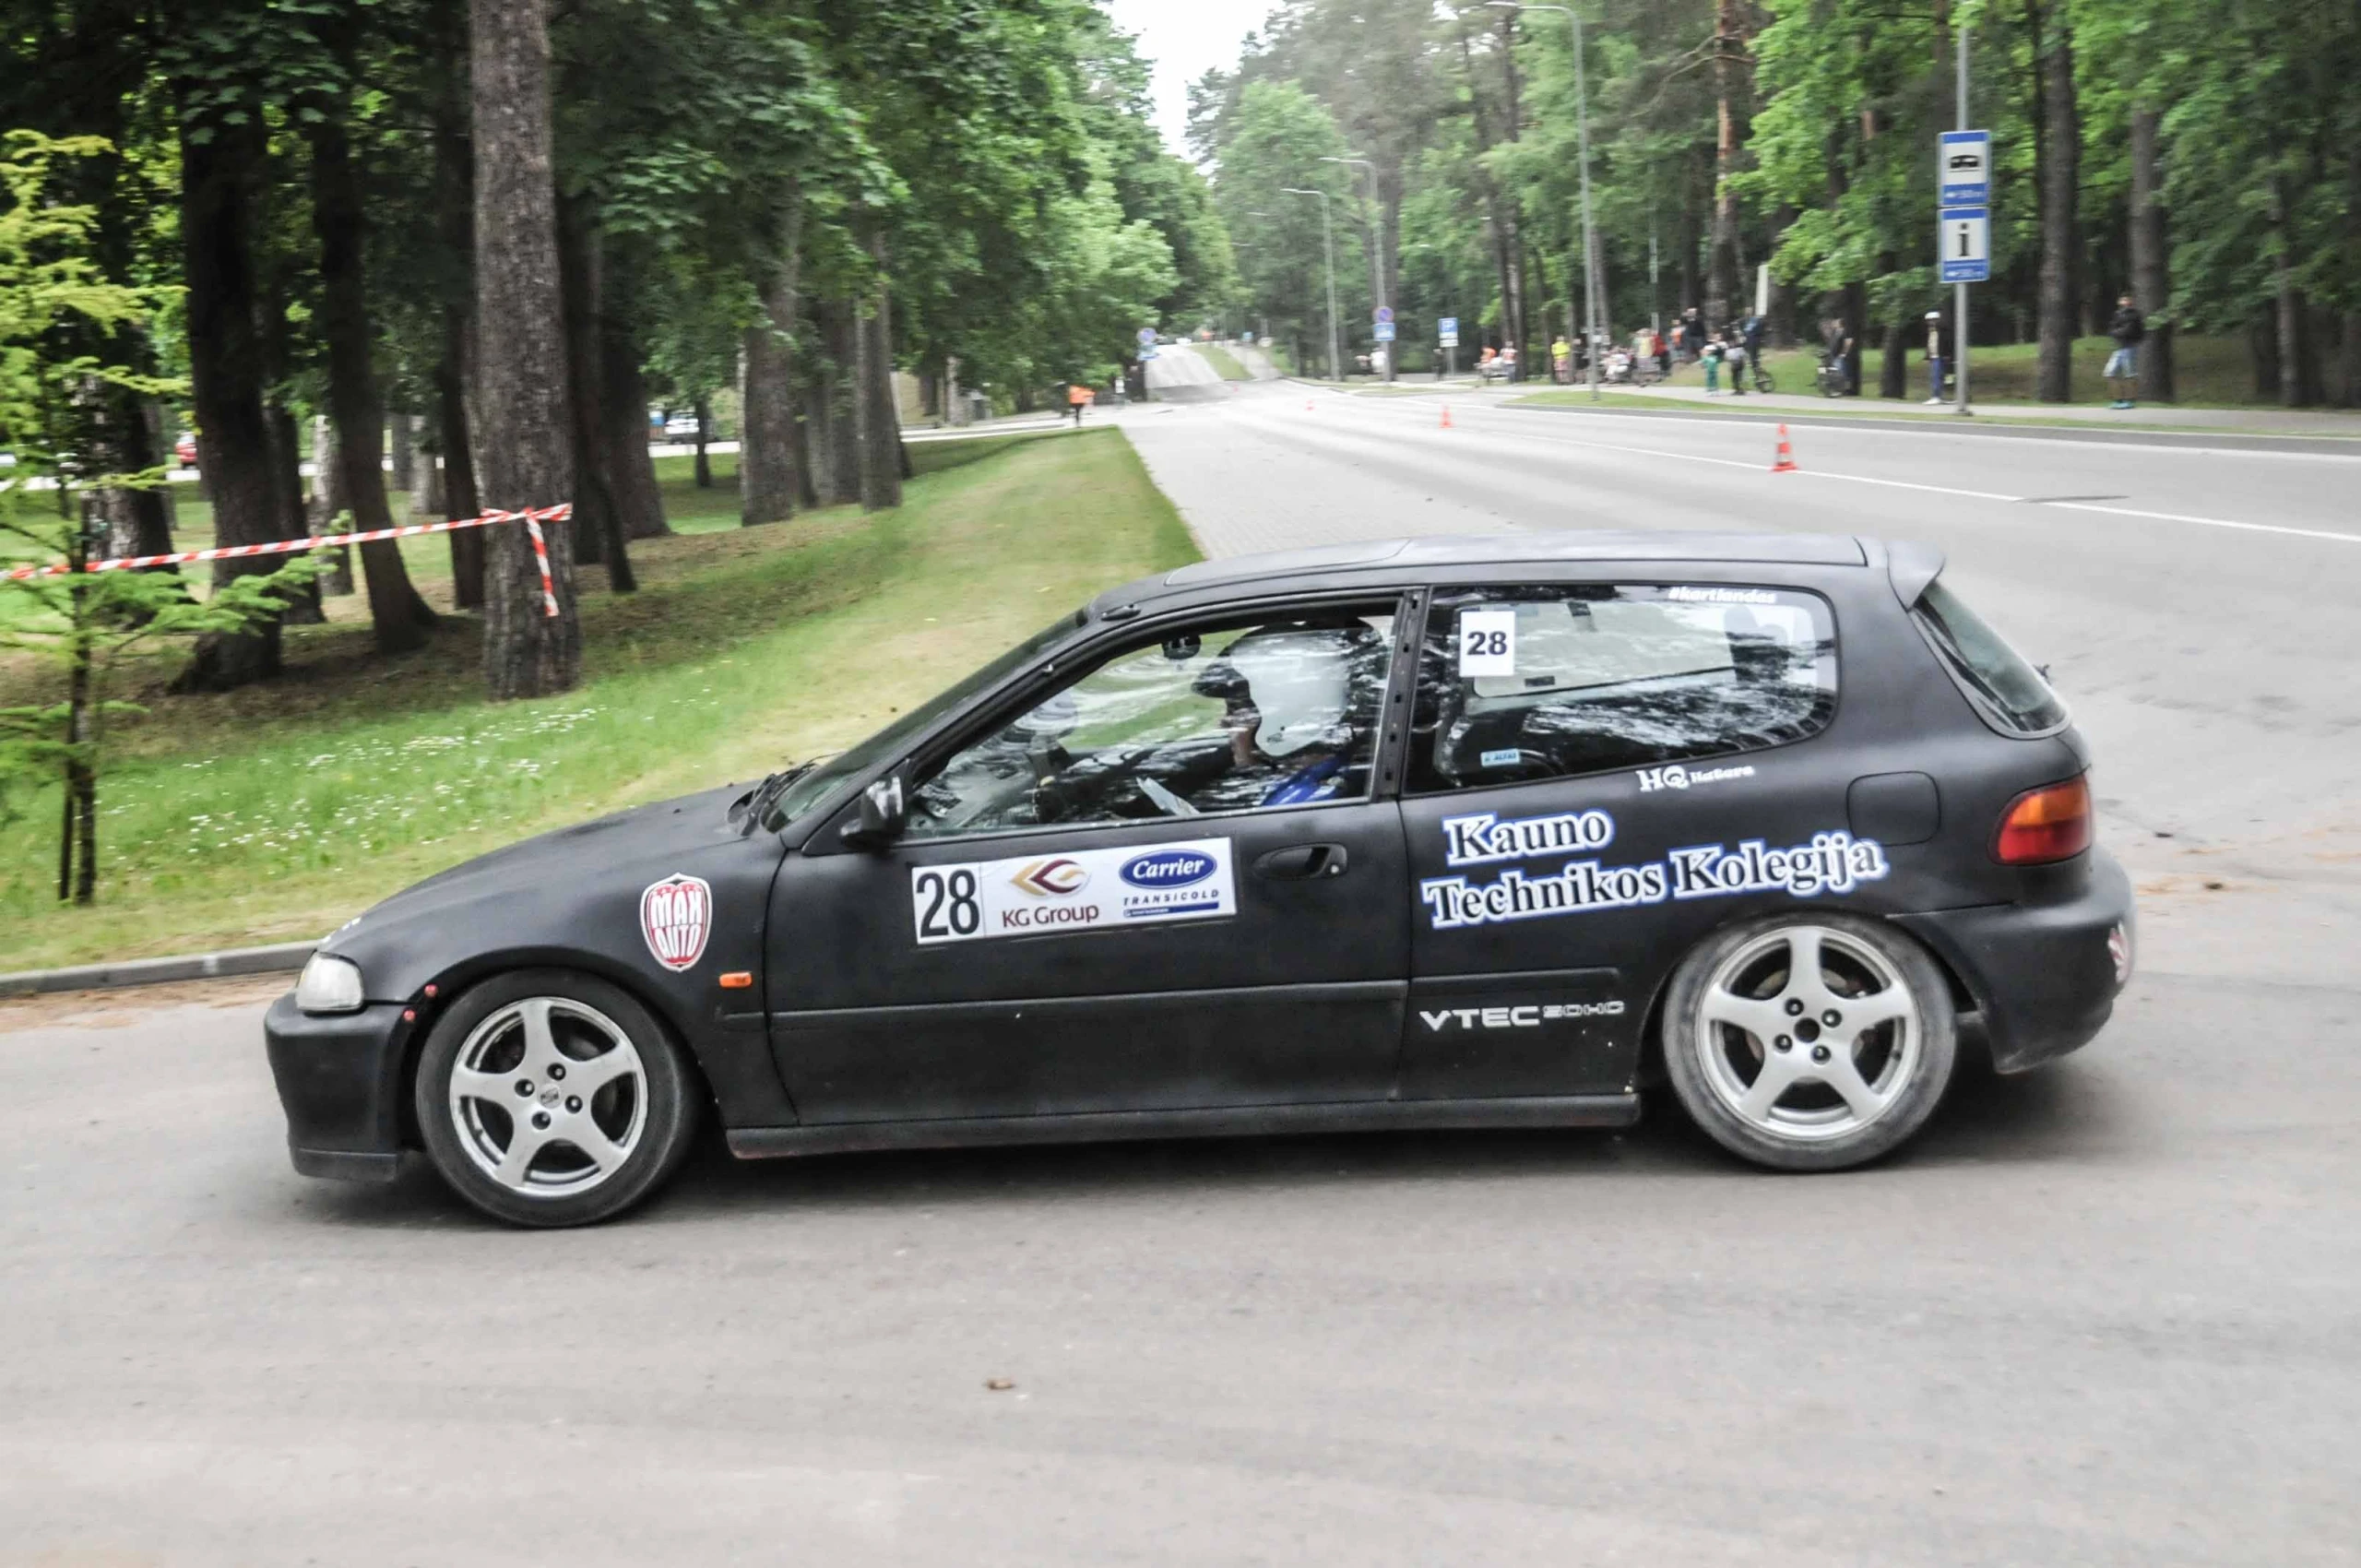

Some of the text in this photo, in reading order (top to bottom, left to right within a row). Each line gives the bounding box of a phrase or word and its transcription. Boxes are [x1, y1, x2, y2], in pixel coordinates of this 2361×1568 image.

[1466, 631, 1507, 656] 28
[1635, 765, 1690, 792] HQ
[1446, 811, 1610, 863] Kauno
[1133, 858, 1204, 879] Carrier
[1425, 833, 1884, 924] Technikos Kolegija
[650, 891, 703, 929] MAX
[916, 870, 979, 938] 28
[1123, 889, 1219, 906] TRANSICOLD
[1002, 905, 1099, 928] KG Group
[654, 924, 702, 958] AUTO
[1419, 1006, 1540, 1031] VTEC
